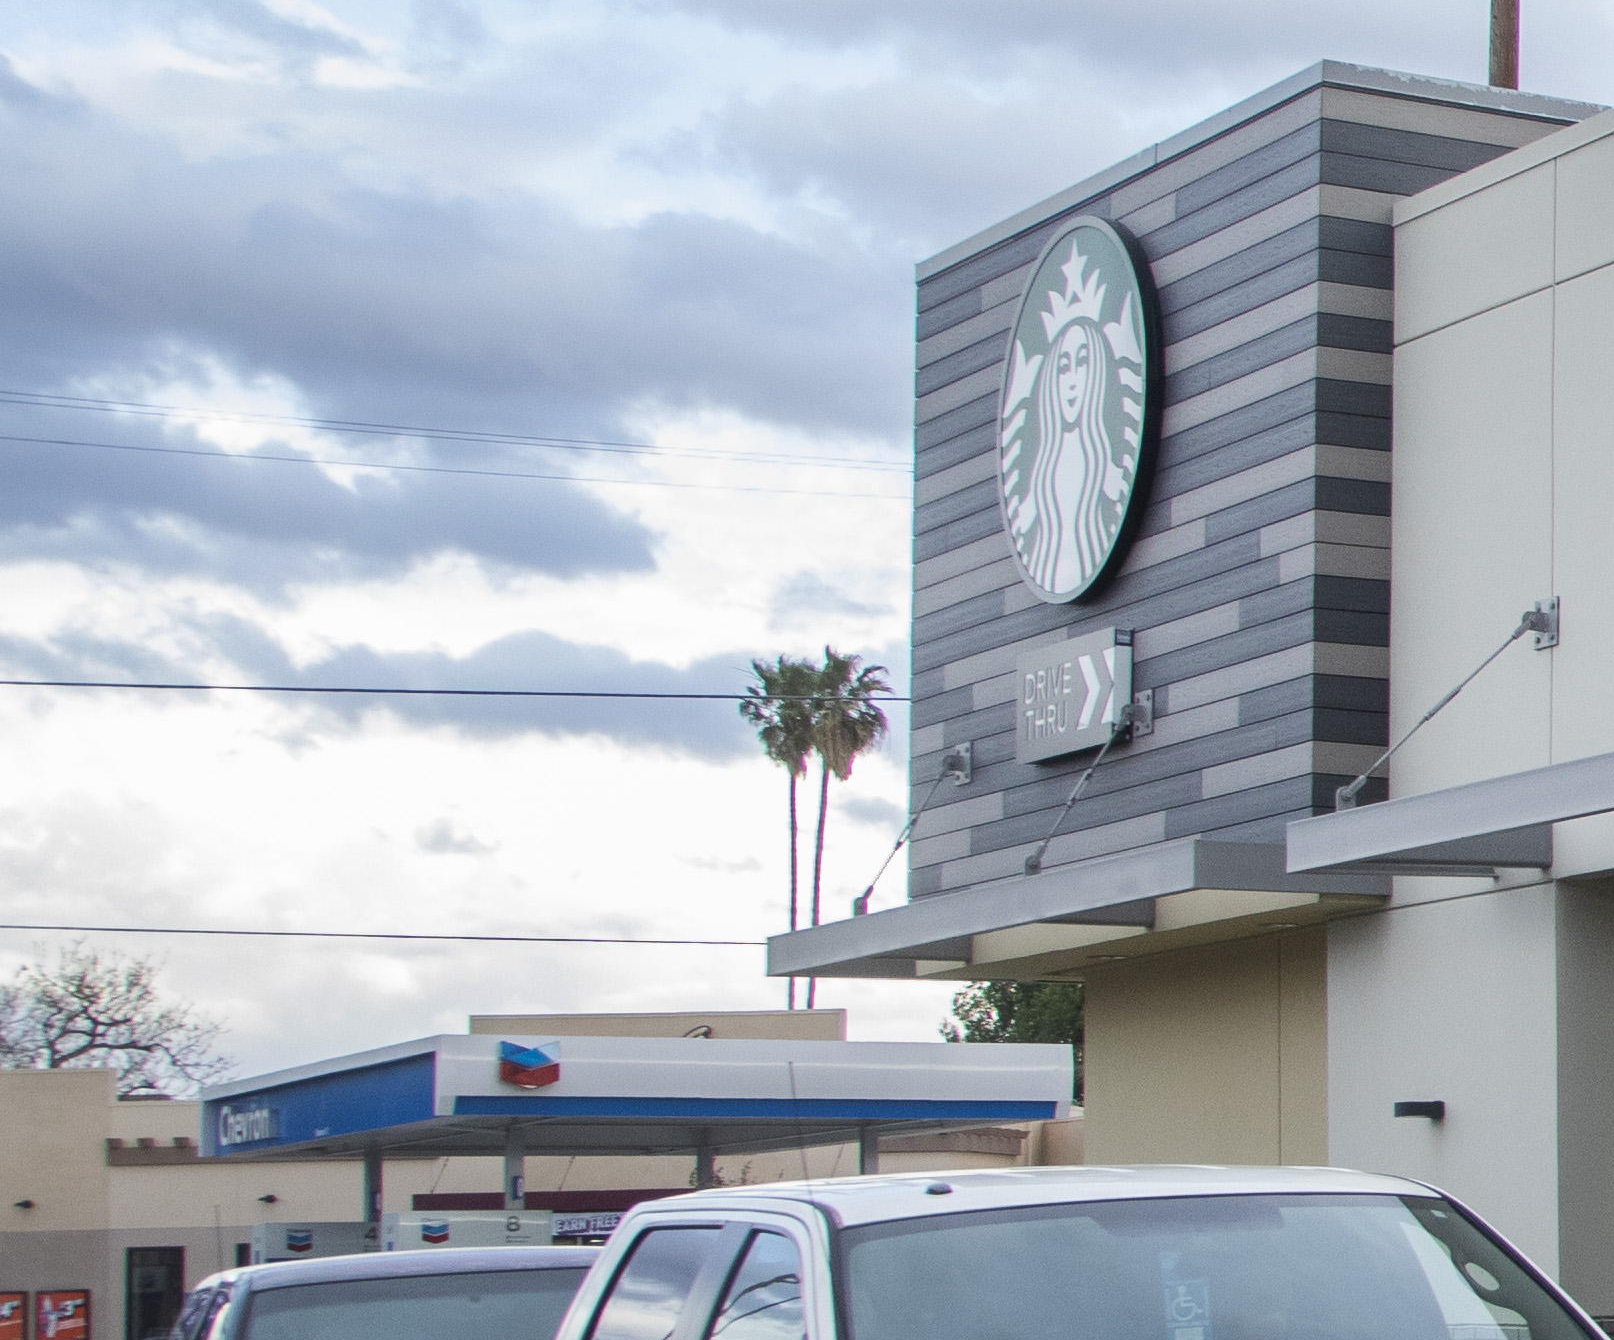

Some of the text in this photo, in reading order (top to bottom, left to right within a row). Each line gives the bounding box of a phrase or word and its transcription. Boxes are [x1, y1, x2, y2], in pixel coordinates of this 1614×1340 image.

[1024, 661, 1072, 705] DRIVE
[1024, 701, 1068, 741] THRU
[219, 1105, 270, 1146] Chevron
[506, 1215, 521, 1233] 8
[555, 1215, 620, 1231] EARN FREE
